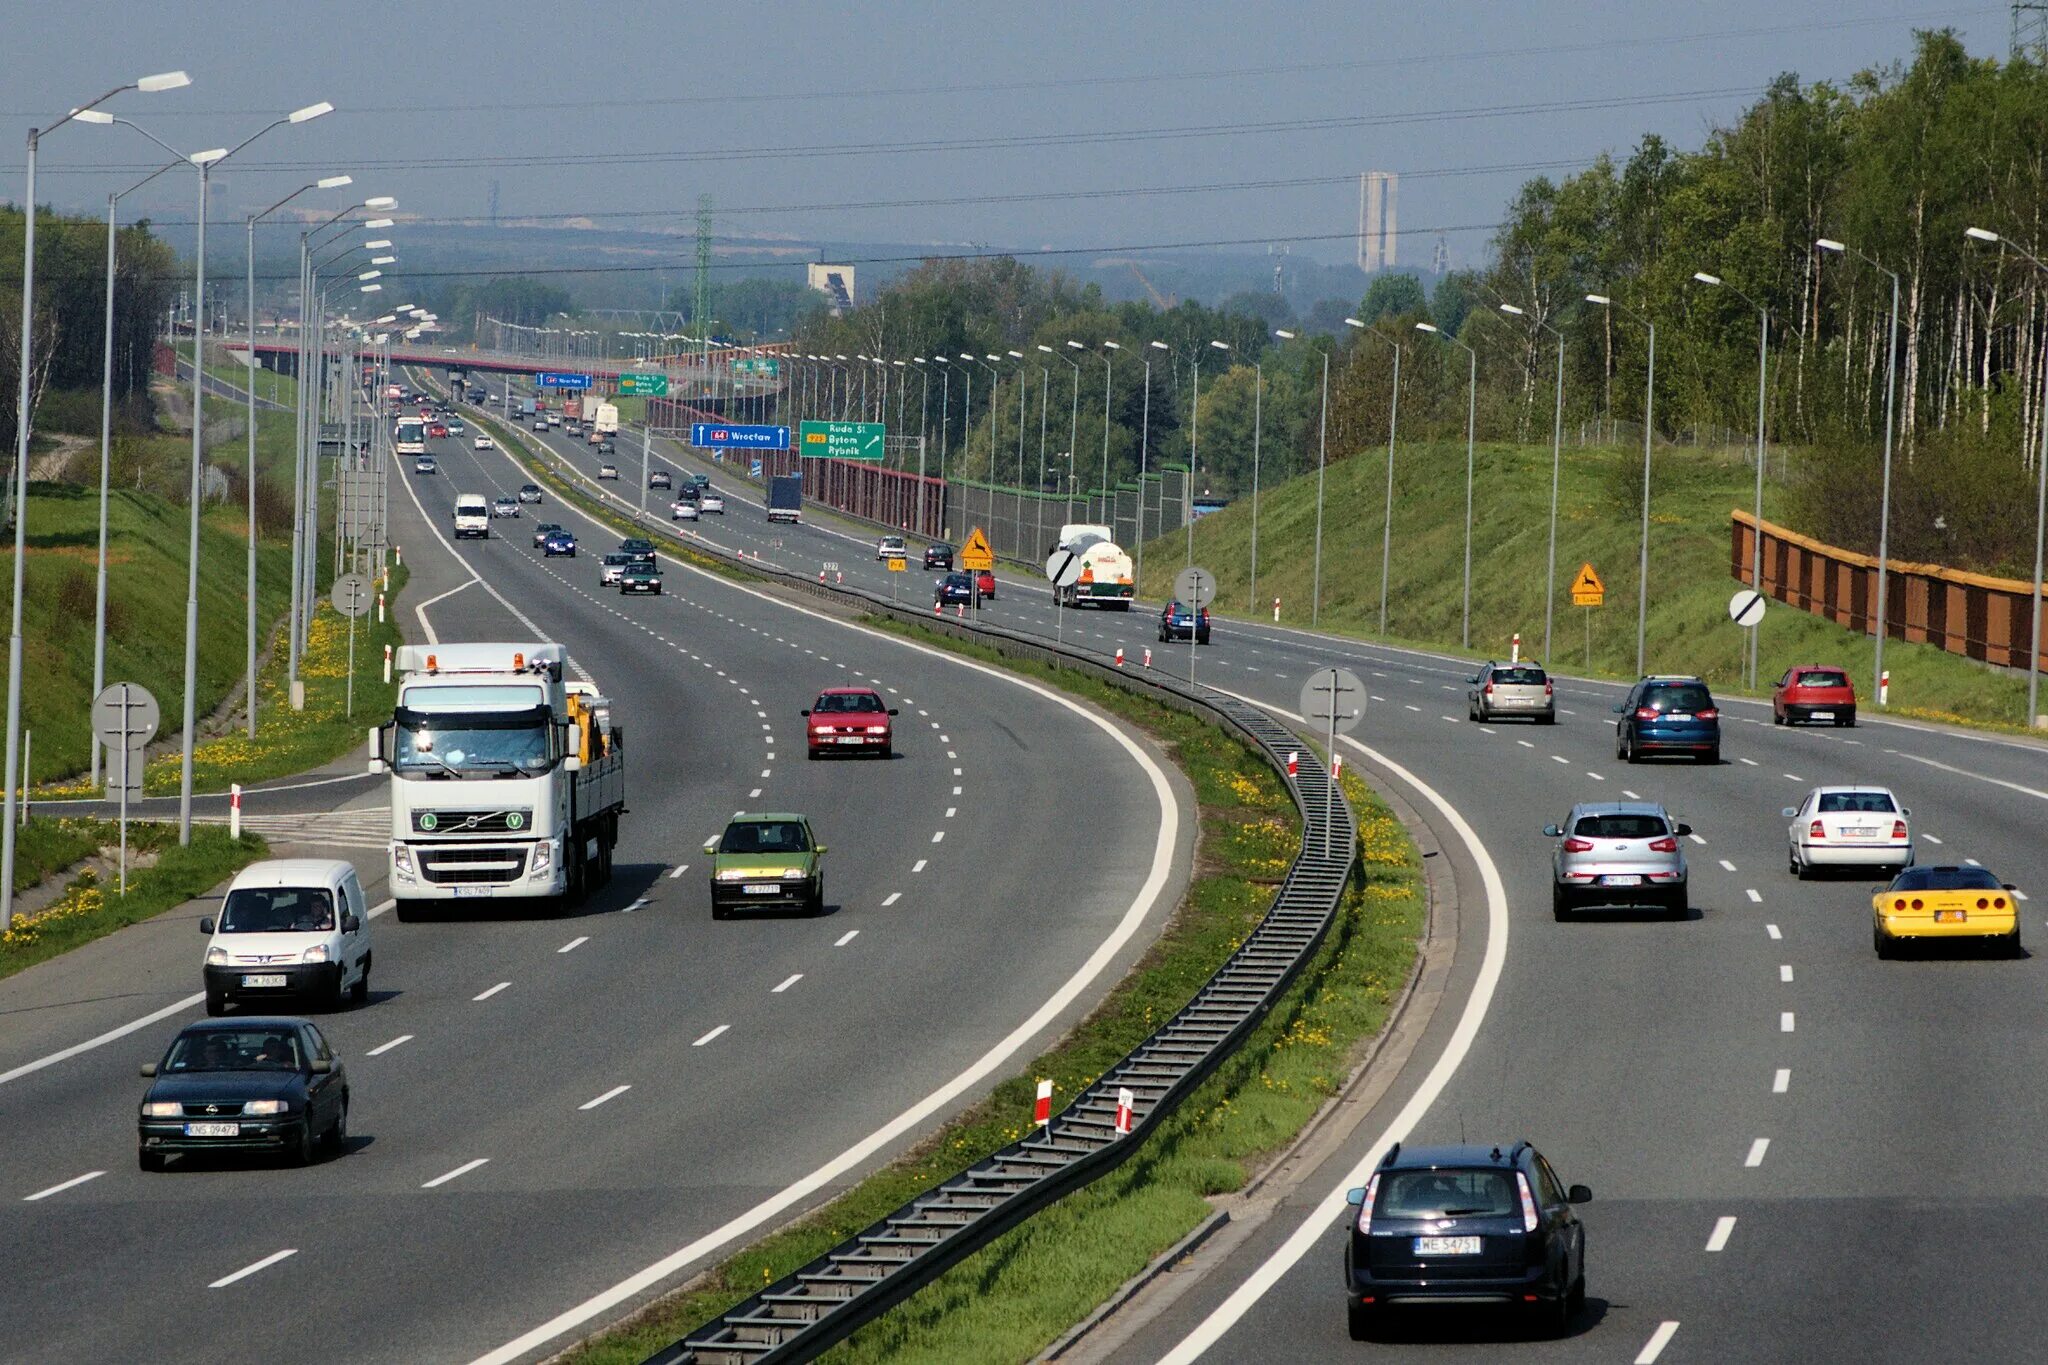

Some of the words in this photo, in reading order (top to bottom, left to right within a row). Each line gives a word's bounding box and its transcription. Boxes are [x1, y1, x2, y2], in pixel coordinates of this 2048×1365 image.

[829, 424, 853, 433] Ruda
[714, 432, 725, 440] A4
[731, 431, 771, 441] Wrocław
[828, 434, 858, 445] Bytom
[828, 445, 860, 457] Rybnik
[424, 816, 432, 827] L
[510, 815, 519, 825] V
[1422, 1239, 1439, 1250] WE
